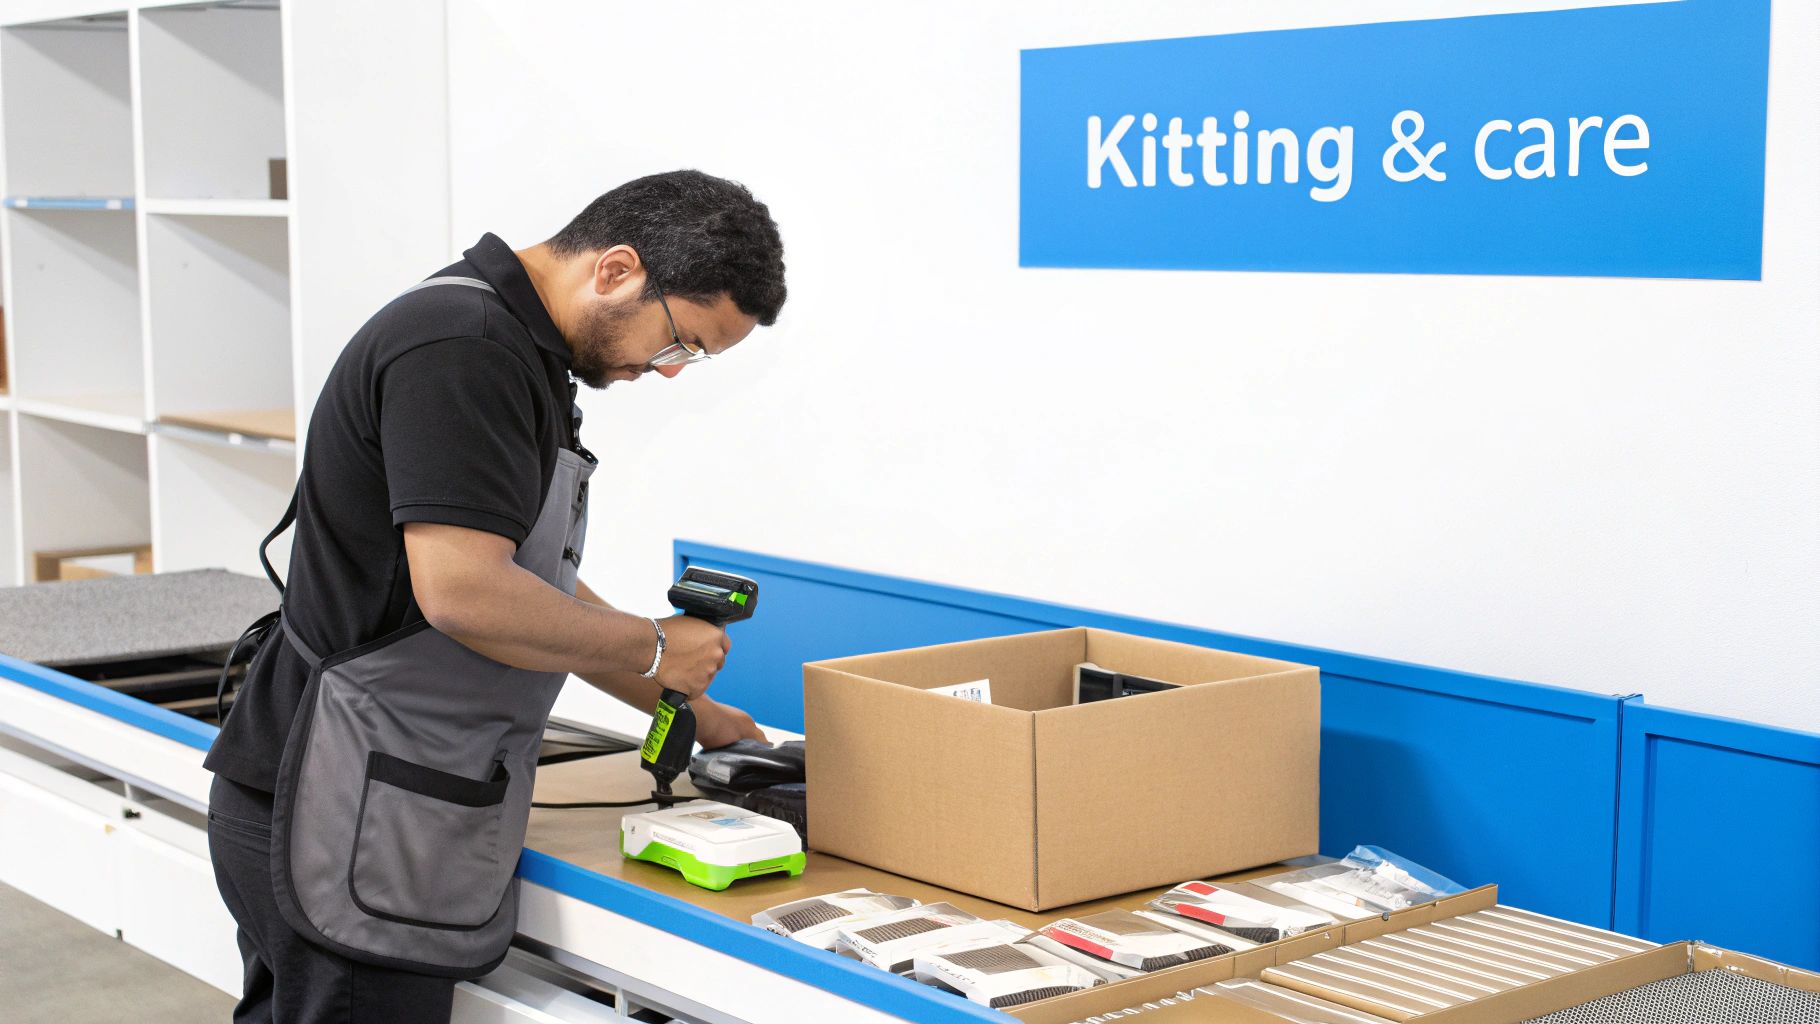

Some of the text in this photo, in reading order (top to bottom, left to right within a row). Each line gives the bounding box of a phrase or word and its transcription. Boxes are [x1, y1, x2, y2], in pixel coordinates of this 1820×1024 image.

[1087, 109, 1650, 203] Kitting & care
